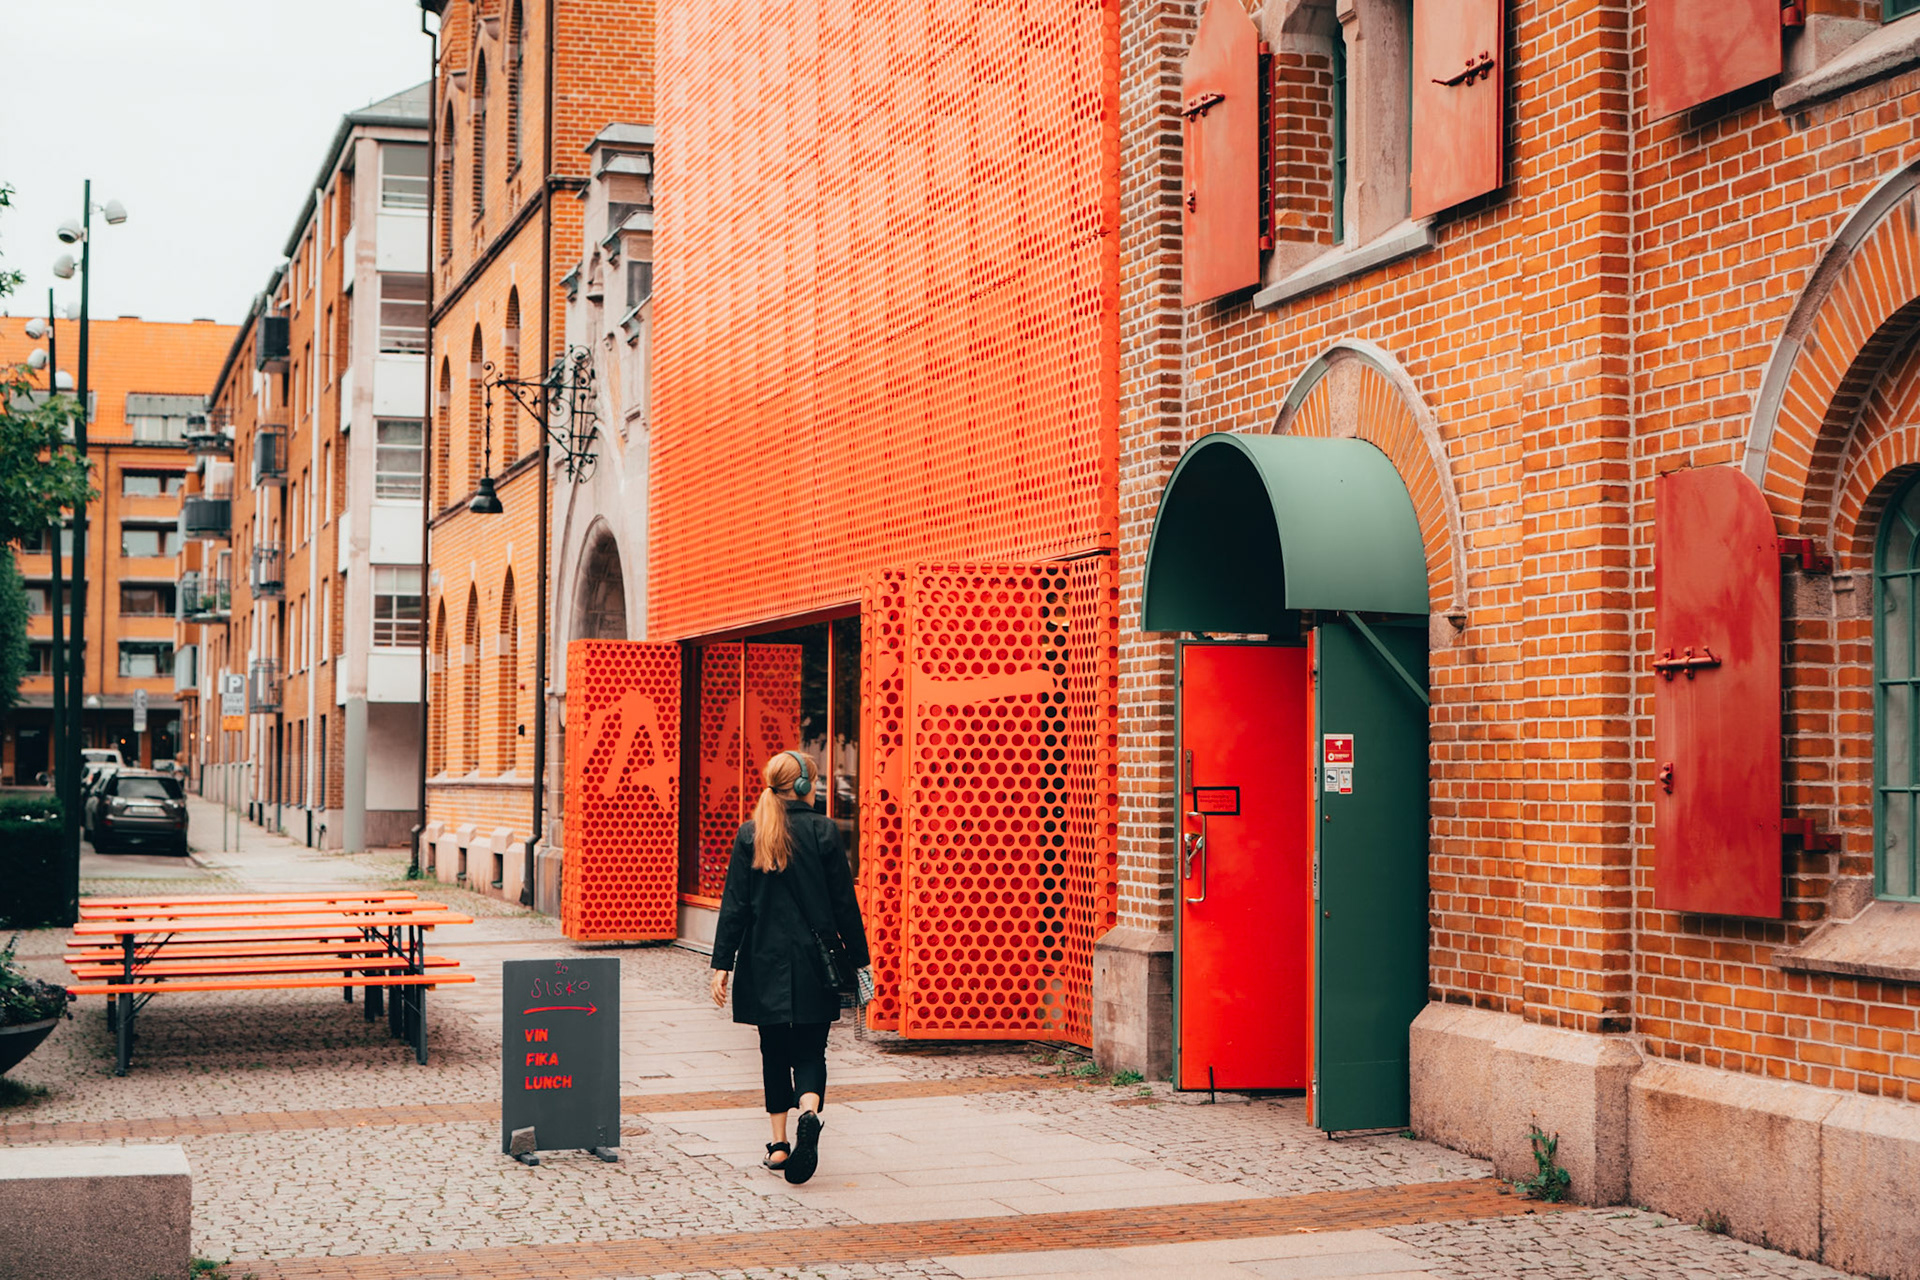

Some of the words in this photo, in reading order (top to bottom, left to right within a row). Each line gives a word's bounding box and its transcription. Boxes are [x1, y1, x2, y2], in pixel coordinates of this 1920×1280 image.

[229, 676, 241, 693] P
[530, 978, 590, 998] SISKO
[525, 1029, 548, 1042] VIN
[526, 1053, 559, 1066] FIKA
[525, 1076, 572, 1090] LUNCH
